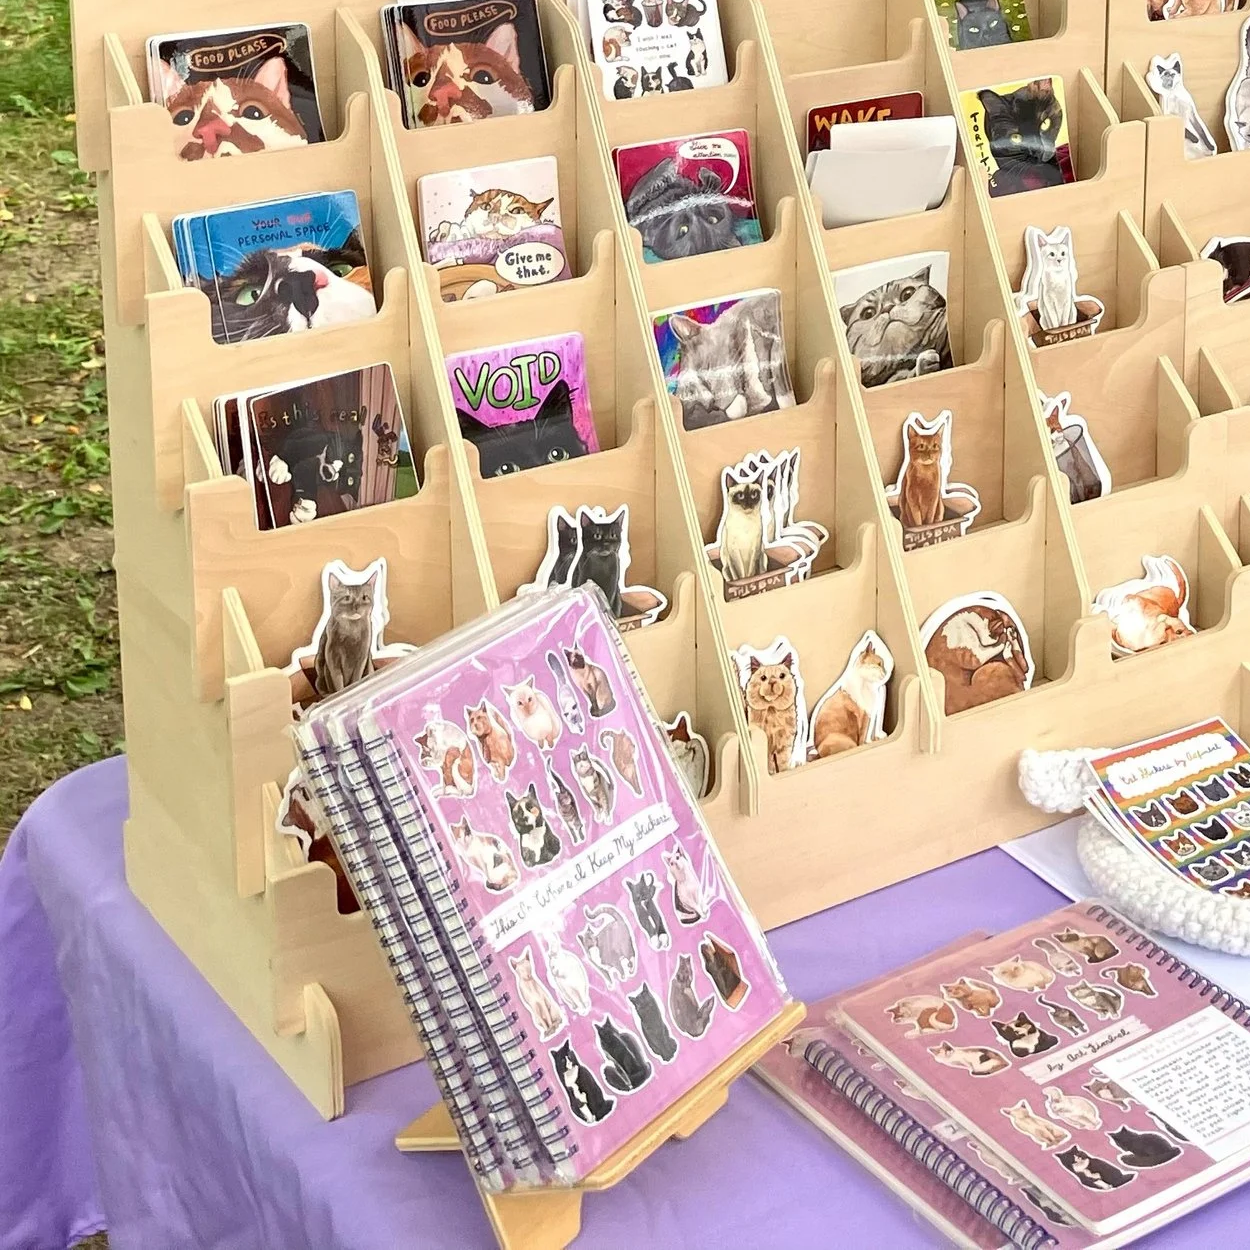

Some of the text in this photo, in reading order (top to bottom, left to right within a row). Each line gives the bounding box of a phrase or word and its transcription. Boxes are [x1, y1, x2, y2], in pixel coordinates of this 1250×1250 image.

[430, 4, 498, 30] FOOD PLEASE
[194, 38, 268, 66] FOOD PLEASE
[238, 222, 330, 247] PERSONAL SPACE
[253, 218, 281, 231] YOUR
[505, 252, 552, 266] Give me
[516, 265, 550, 279] that.
[454, 351, 561, 411] VOID
[283, 402, 319, 426] this
[905, 525, 957, 543] THIS BOX
[728, 576, 781, 597] THIS BOX
[490, 918, 518, 939] This
[587, 852, 615, 874] Keep
[613, 835, 635, 857] My
[1047, 1028, 1130, 1072] by Art Fimbel
